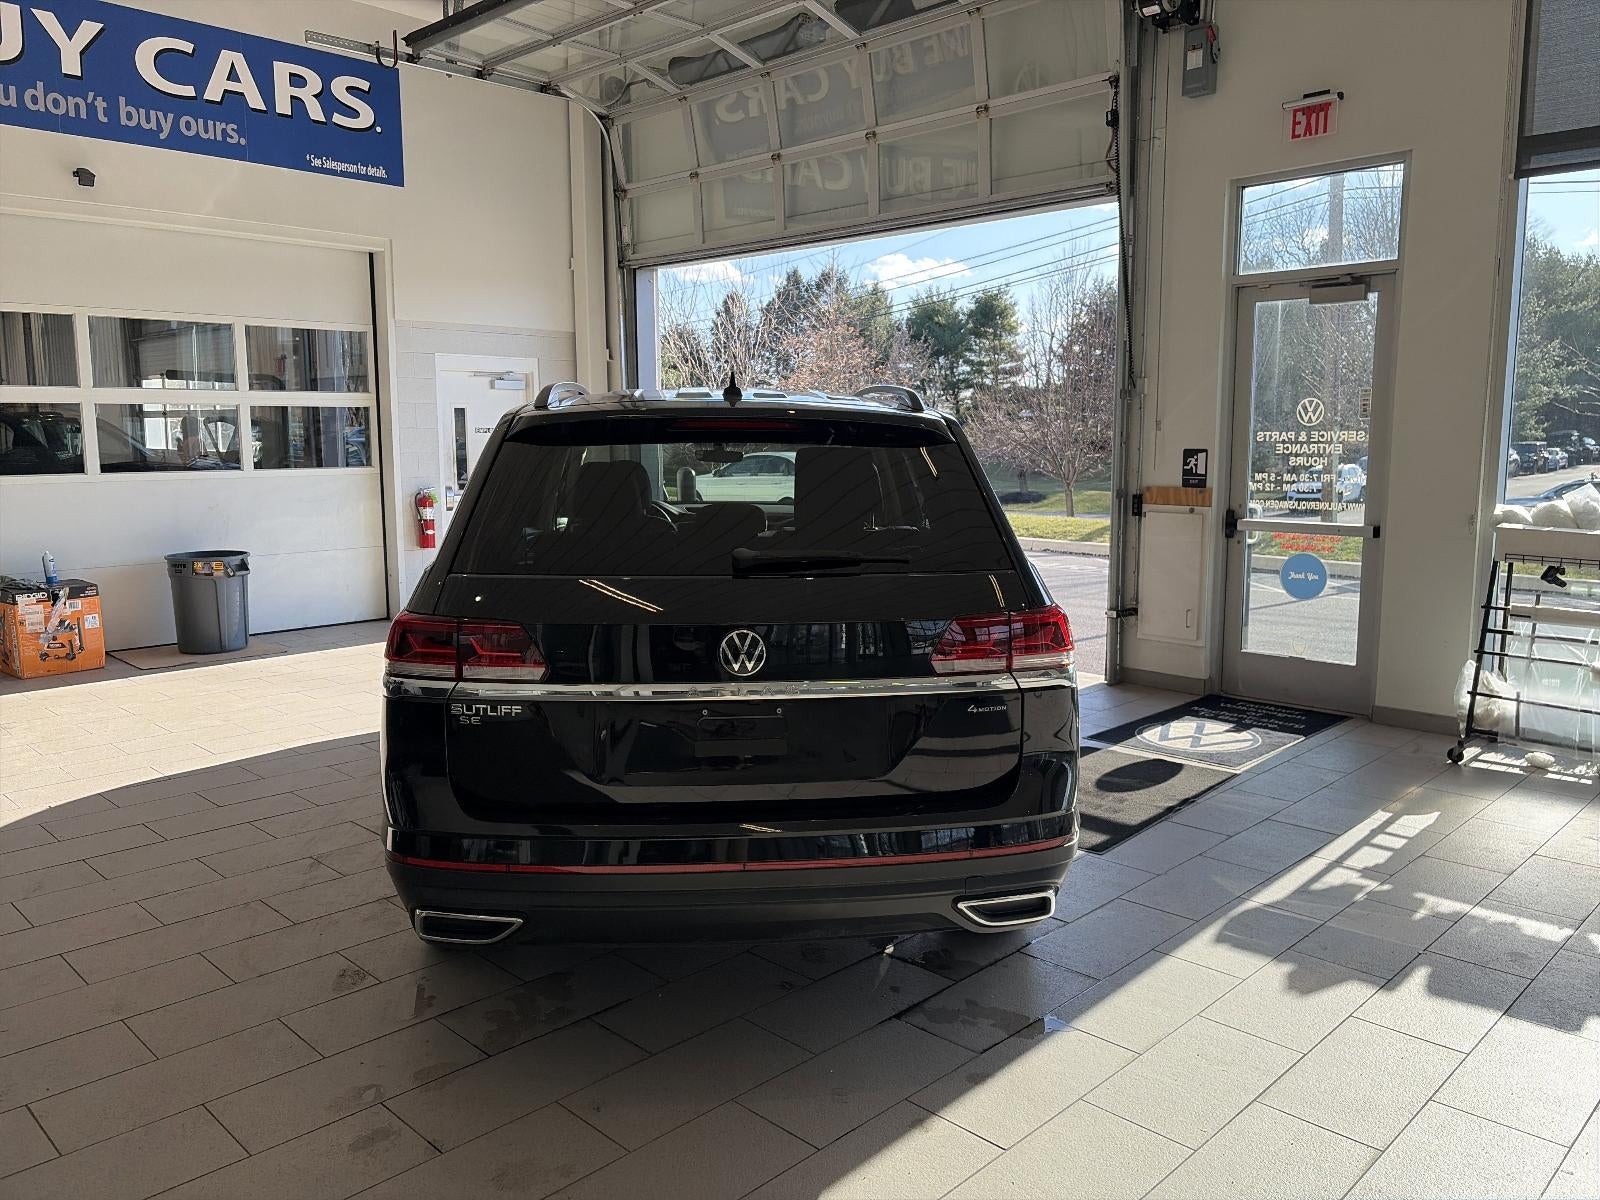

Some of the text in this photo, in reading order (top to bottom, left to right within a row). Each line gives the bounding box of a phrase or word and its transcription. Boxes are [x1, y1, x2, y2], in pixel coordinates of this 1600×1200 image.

[134, 36, 383, 133] CARS.
[24, 80, 108, 123] don't
[119, 95, 175, 140] buy
[179, 115, 246, 146] ours.
[1291, 102, 1331, 140] EXIT
[310, 154, 322, 167] See
[322, 156, 358, 174] Salesperson
[358, 162, 367, 175] for
[367, 164, 388, 178] details.
[1288, 571, 1319, 581] Thank You
[450, 703, 522, 716] SUTLIFF
[459, 715, 481, 725] SE
